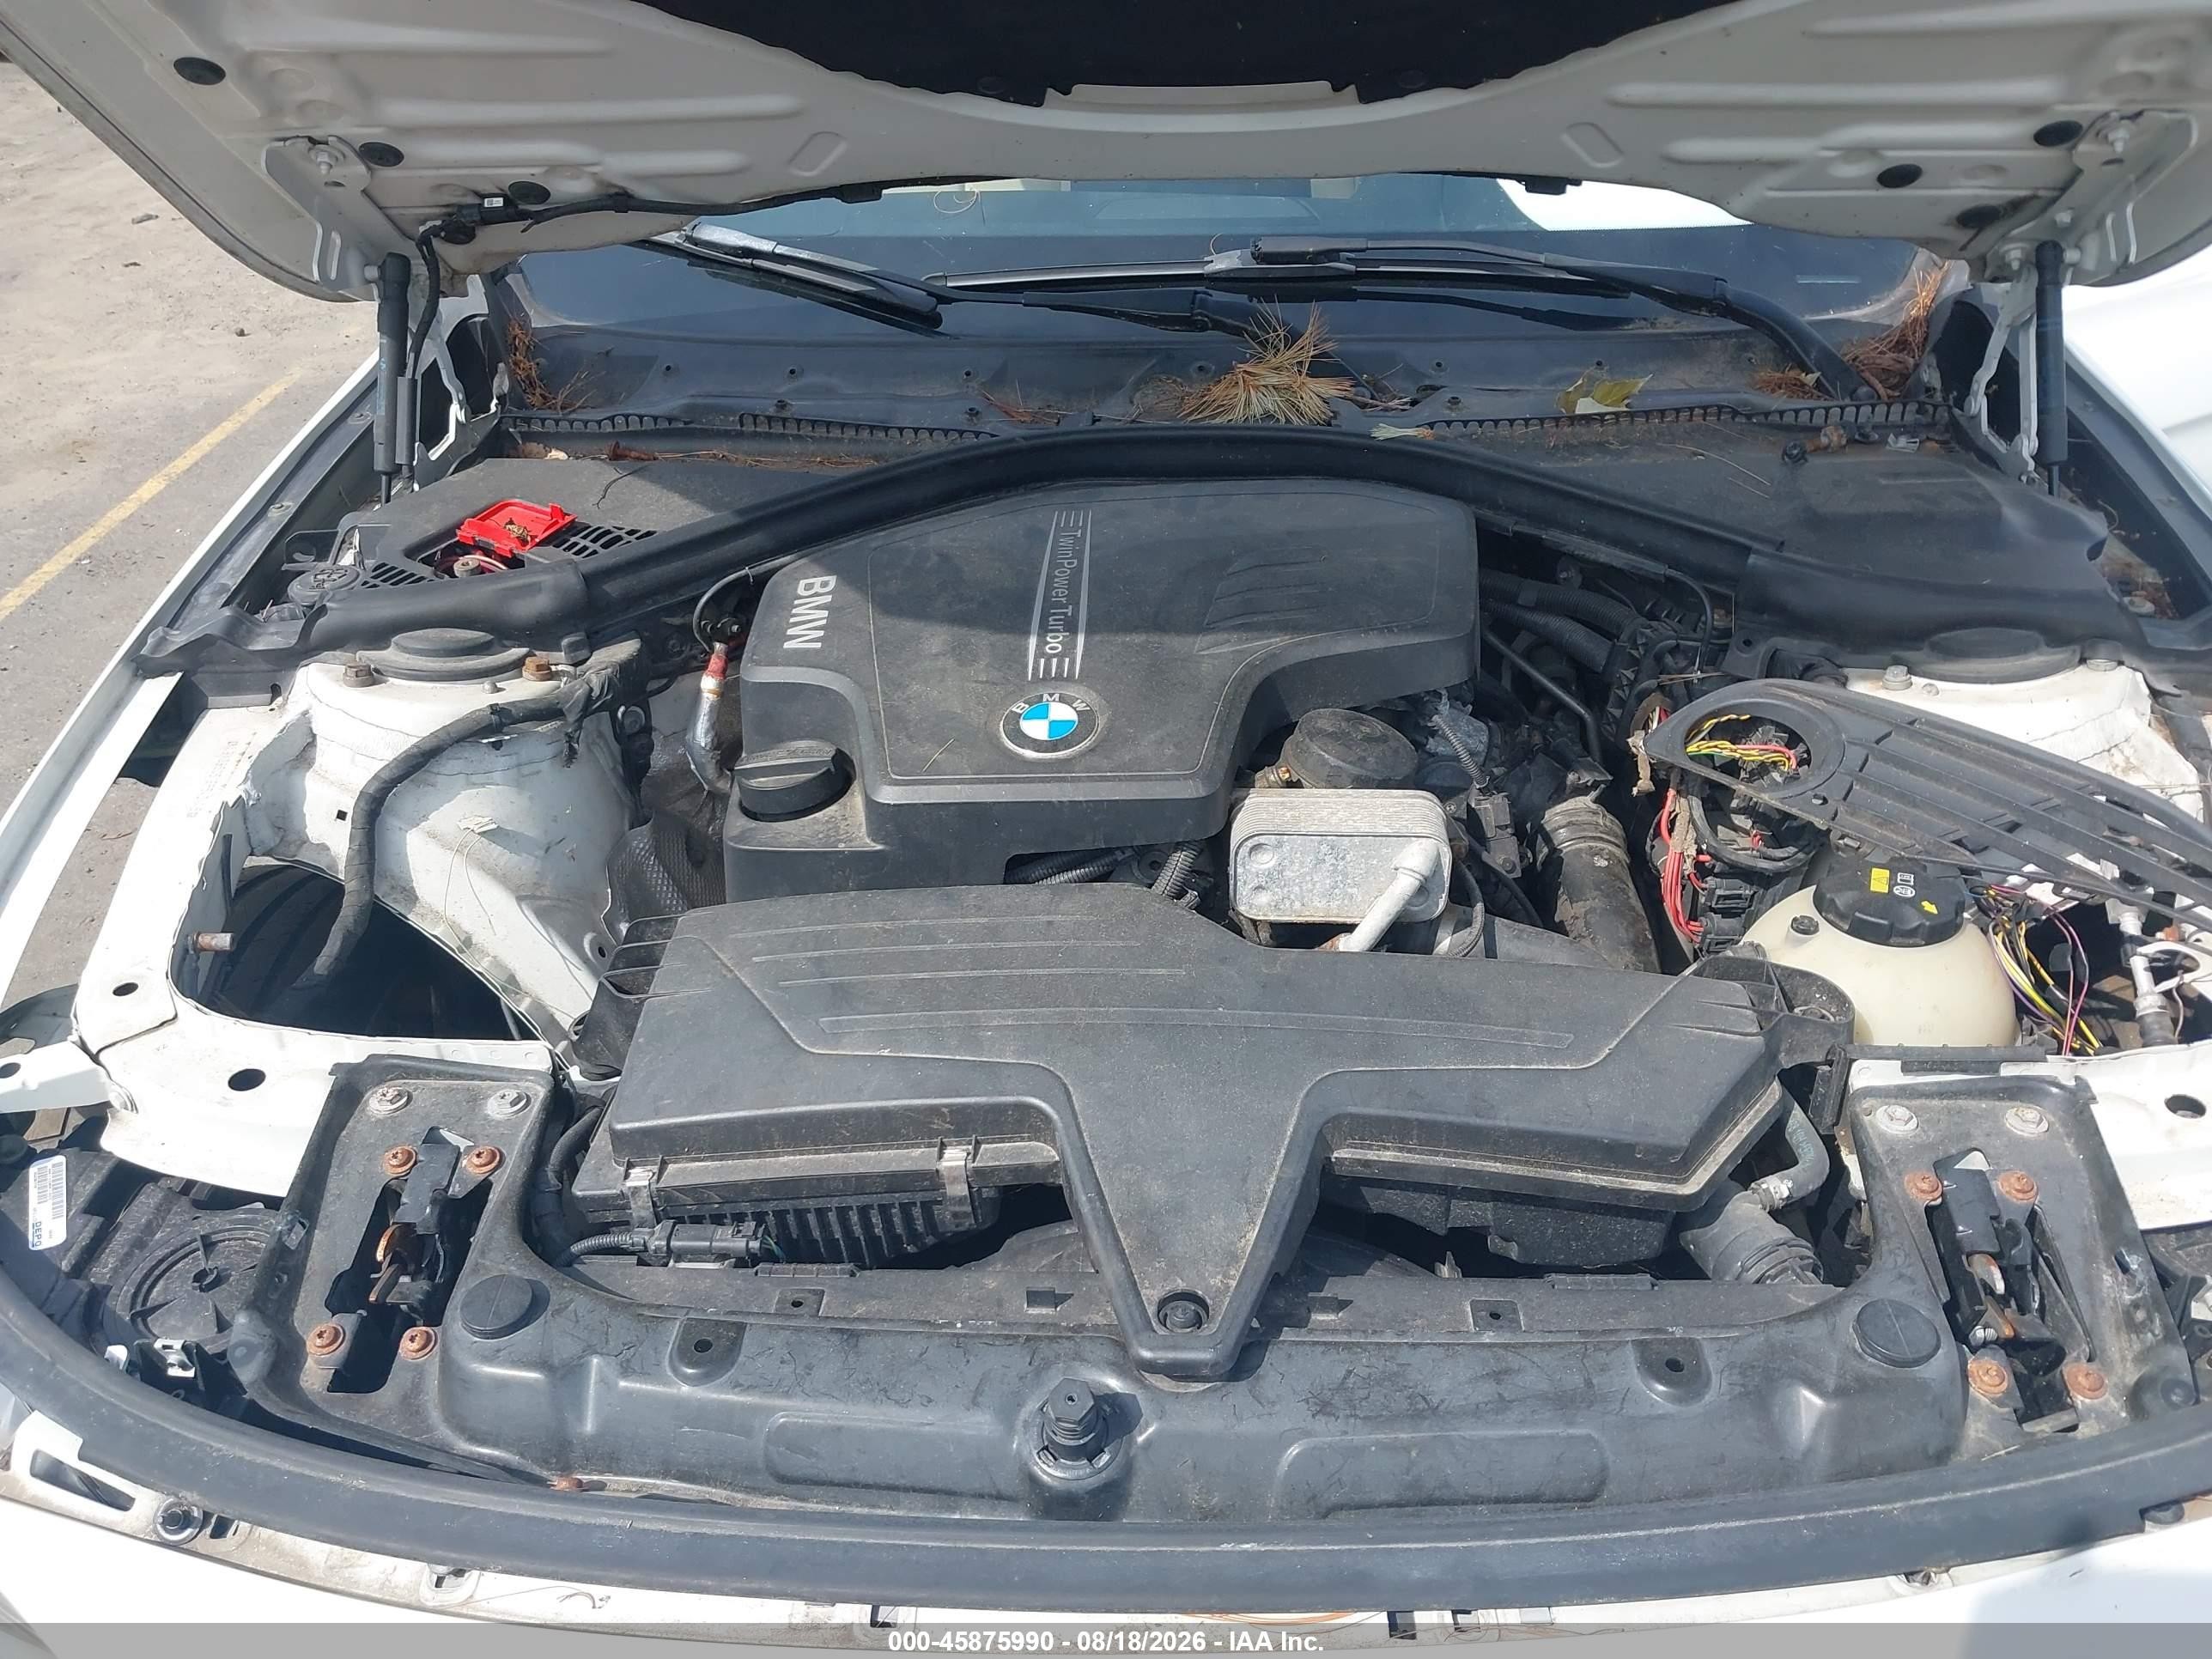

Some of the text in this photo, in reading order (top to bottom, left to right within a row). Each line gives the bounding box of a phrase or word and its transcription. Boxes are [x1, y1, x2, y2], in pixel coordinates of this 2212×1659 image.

[783, 575, 837, 648] BMW
[1045, 529, 1081, 653] TwinPower Turbo
[1012, 693, 1091, 714] BMW
